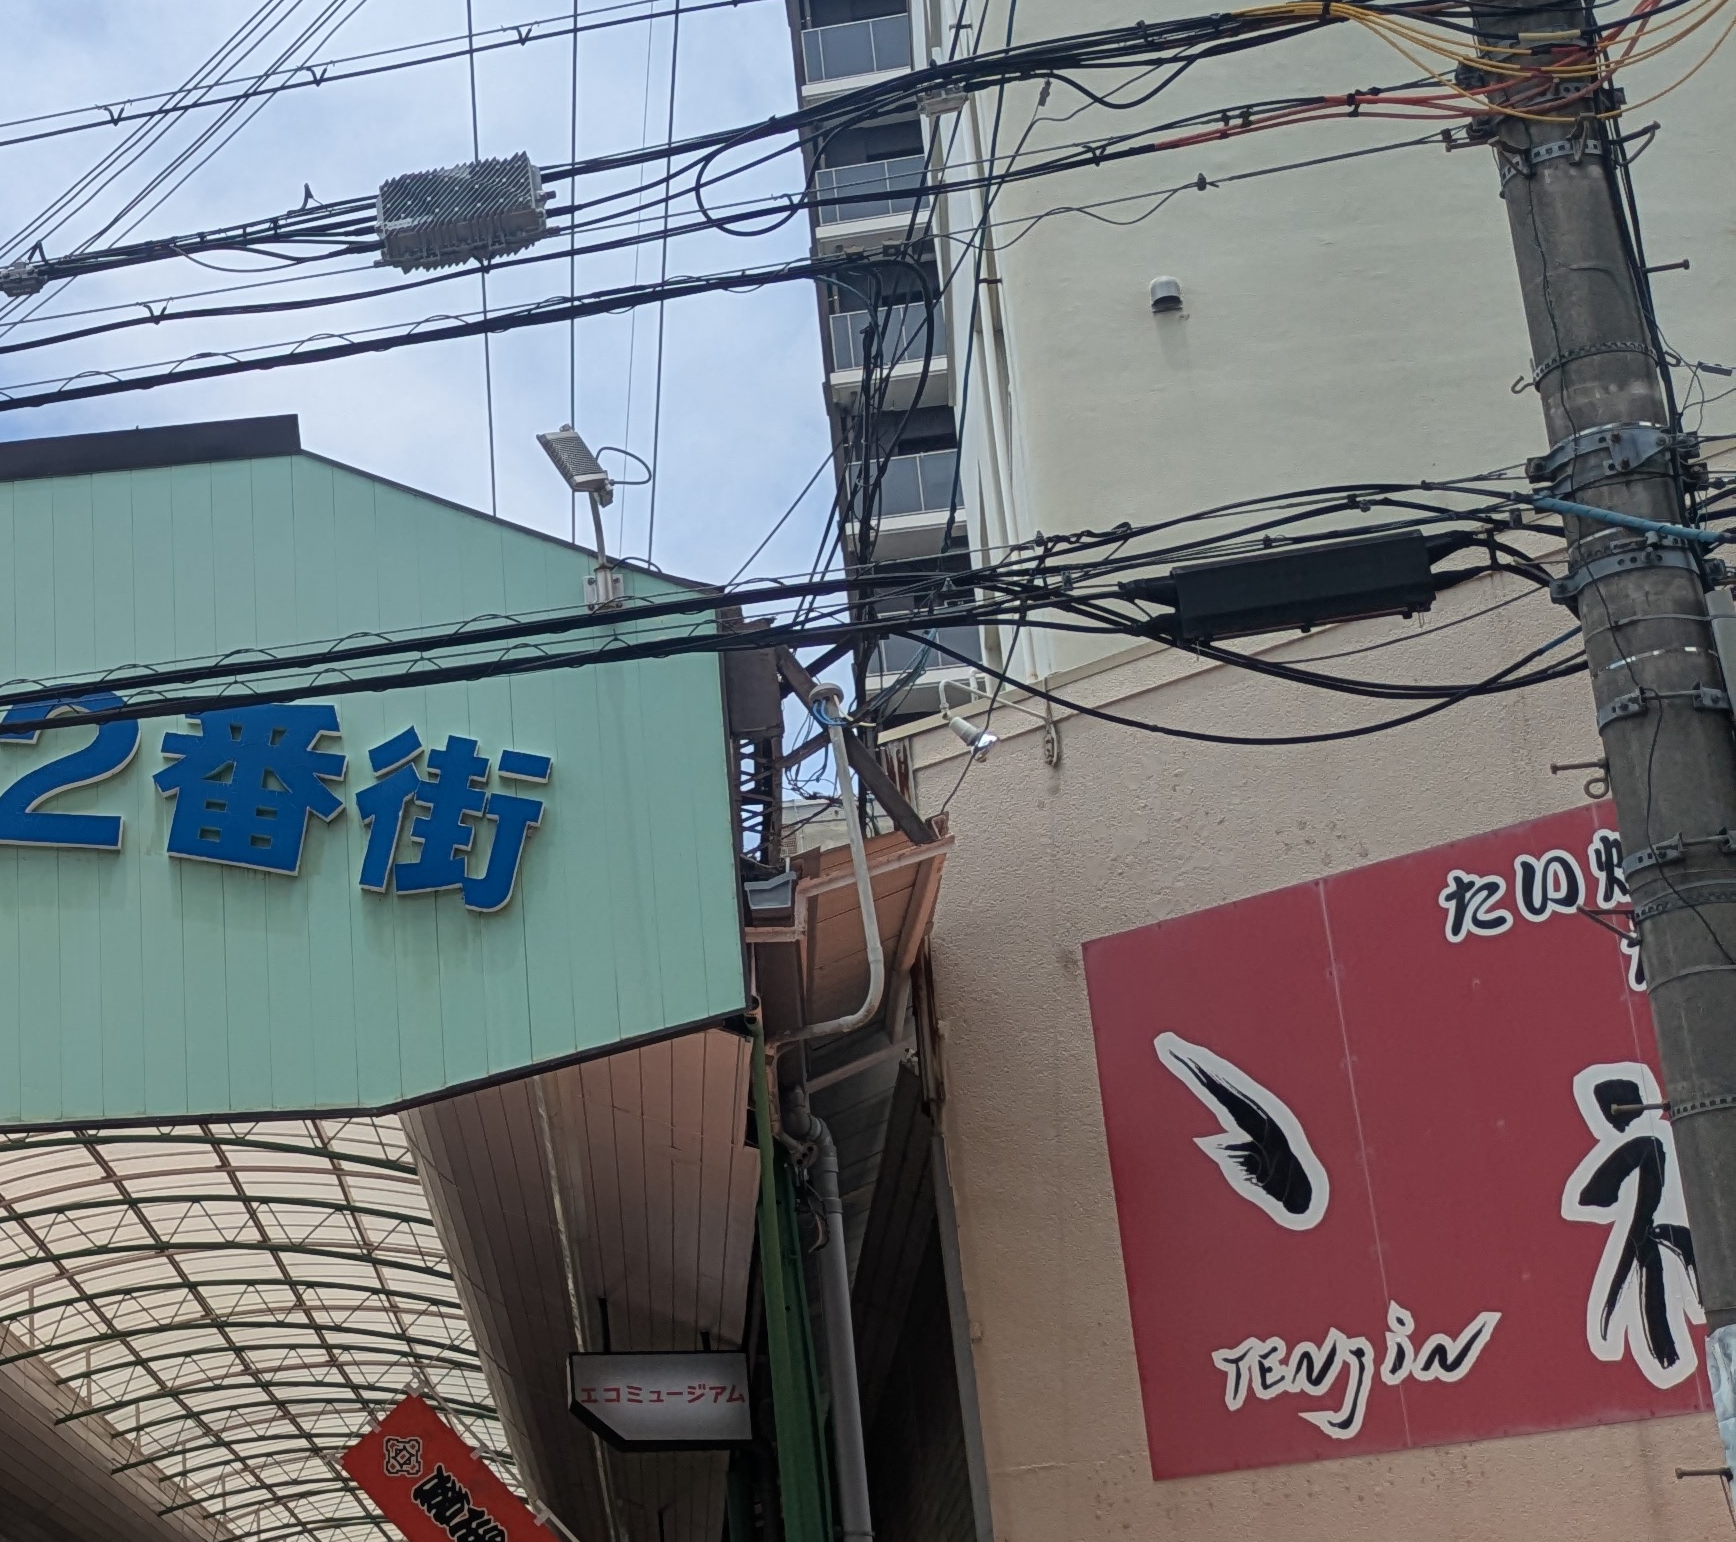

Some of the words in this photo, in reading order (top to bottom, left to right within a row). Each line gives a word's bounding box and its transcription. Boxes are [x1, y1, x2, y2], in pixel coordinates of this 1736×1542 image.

[580, 1384, 746, 1406] エコミュージアム
